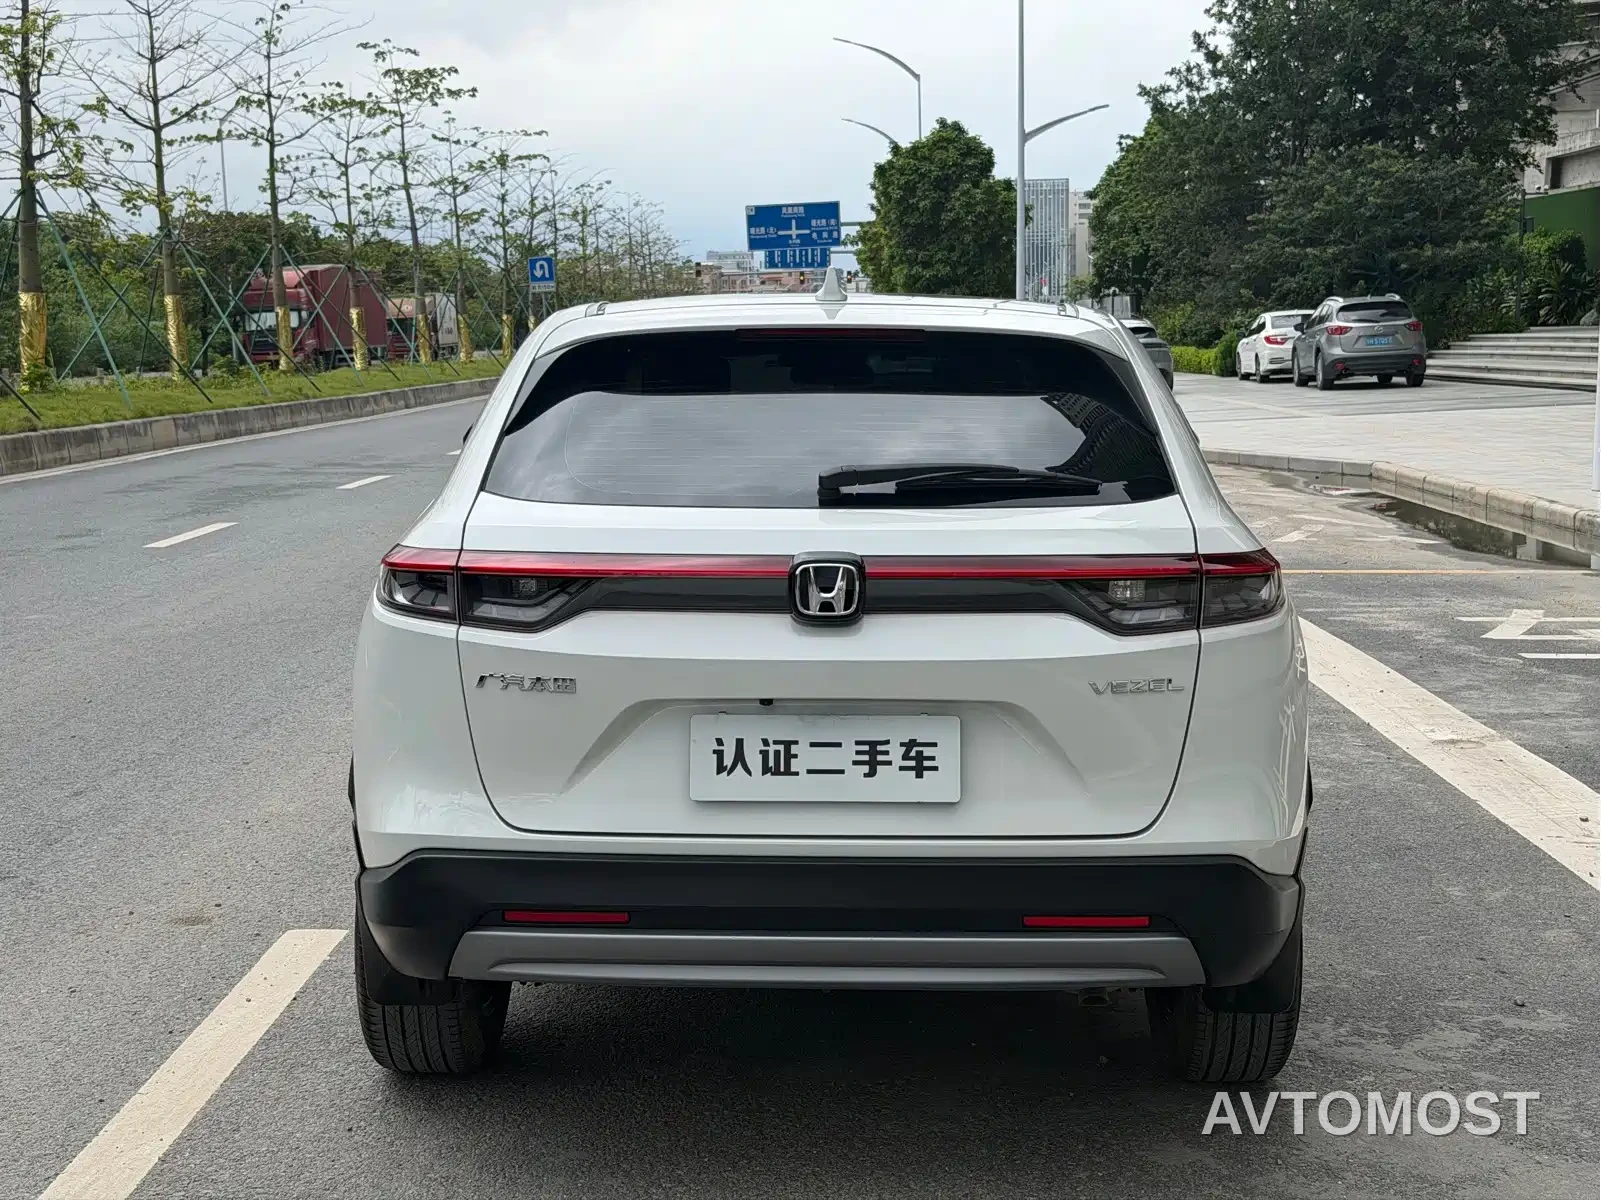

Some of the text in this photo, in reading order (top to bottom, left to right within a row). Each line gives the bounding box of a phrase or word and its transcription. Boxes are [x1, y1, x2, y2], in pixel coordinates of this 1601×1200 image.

[475, 673, 577, 693] 广汽本田
[1088, 678, 1185, 695] VEZEL
[712, 737, 940, 779] 认证二手车
